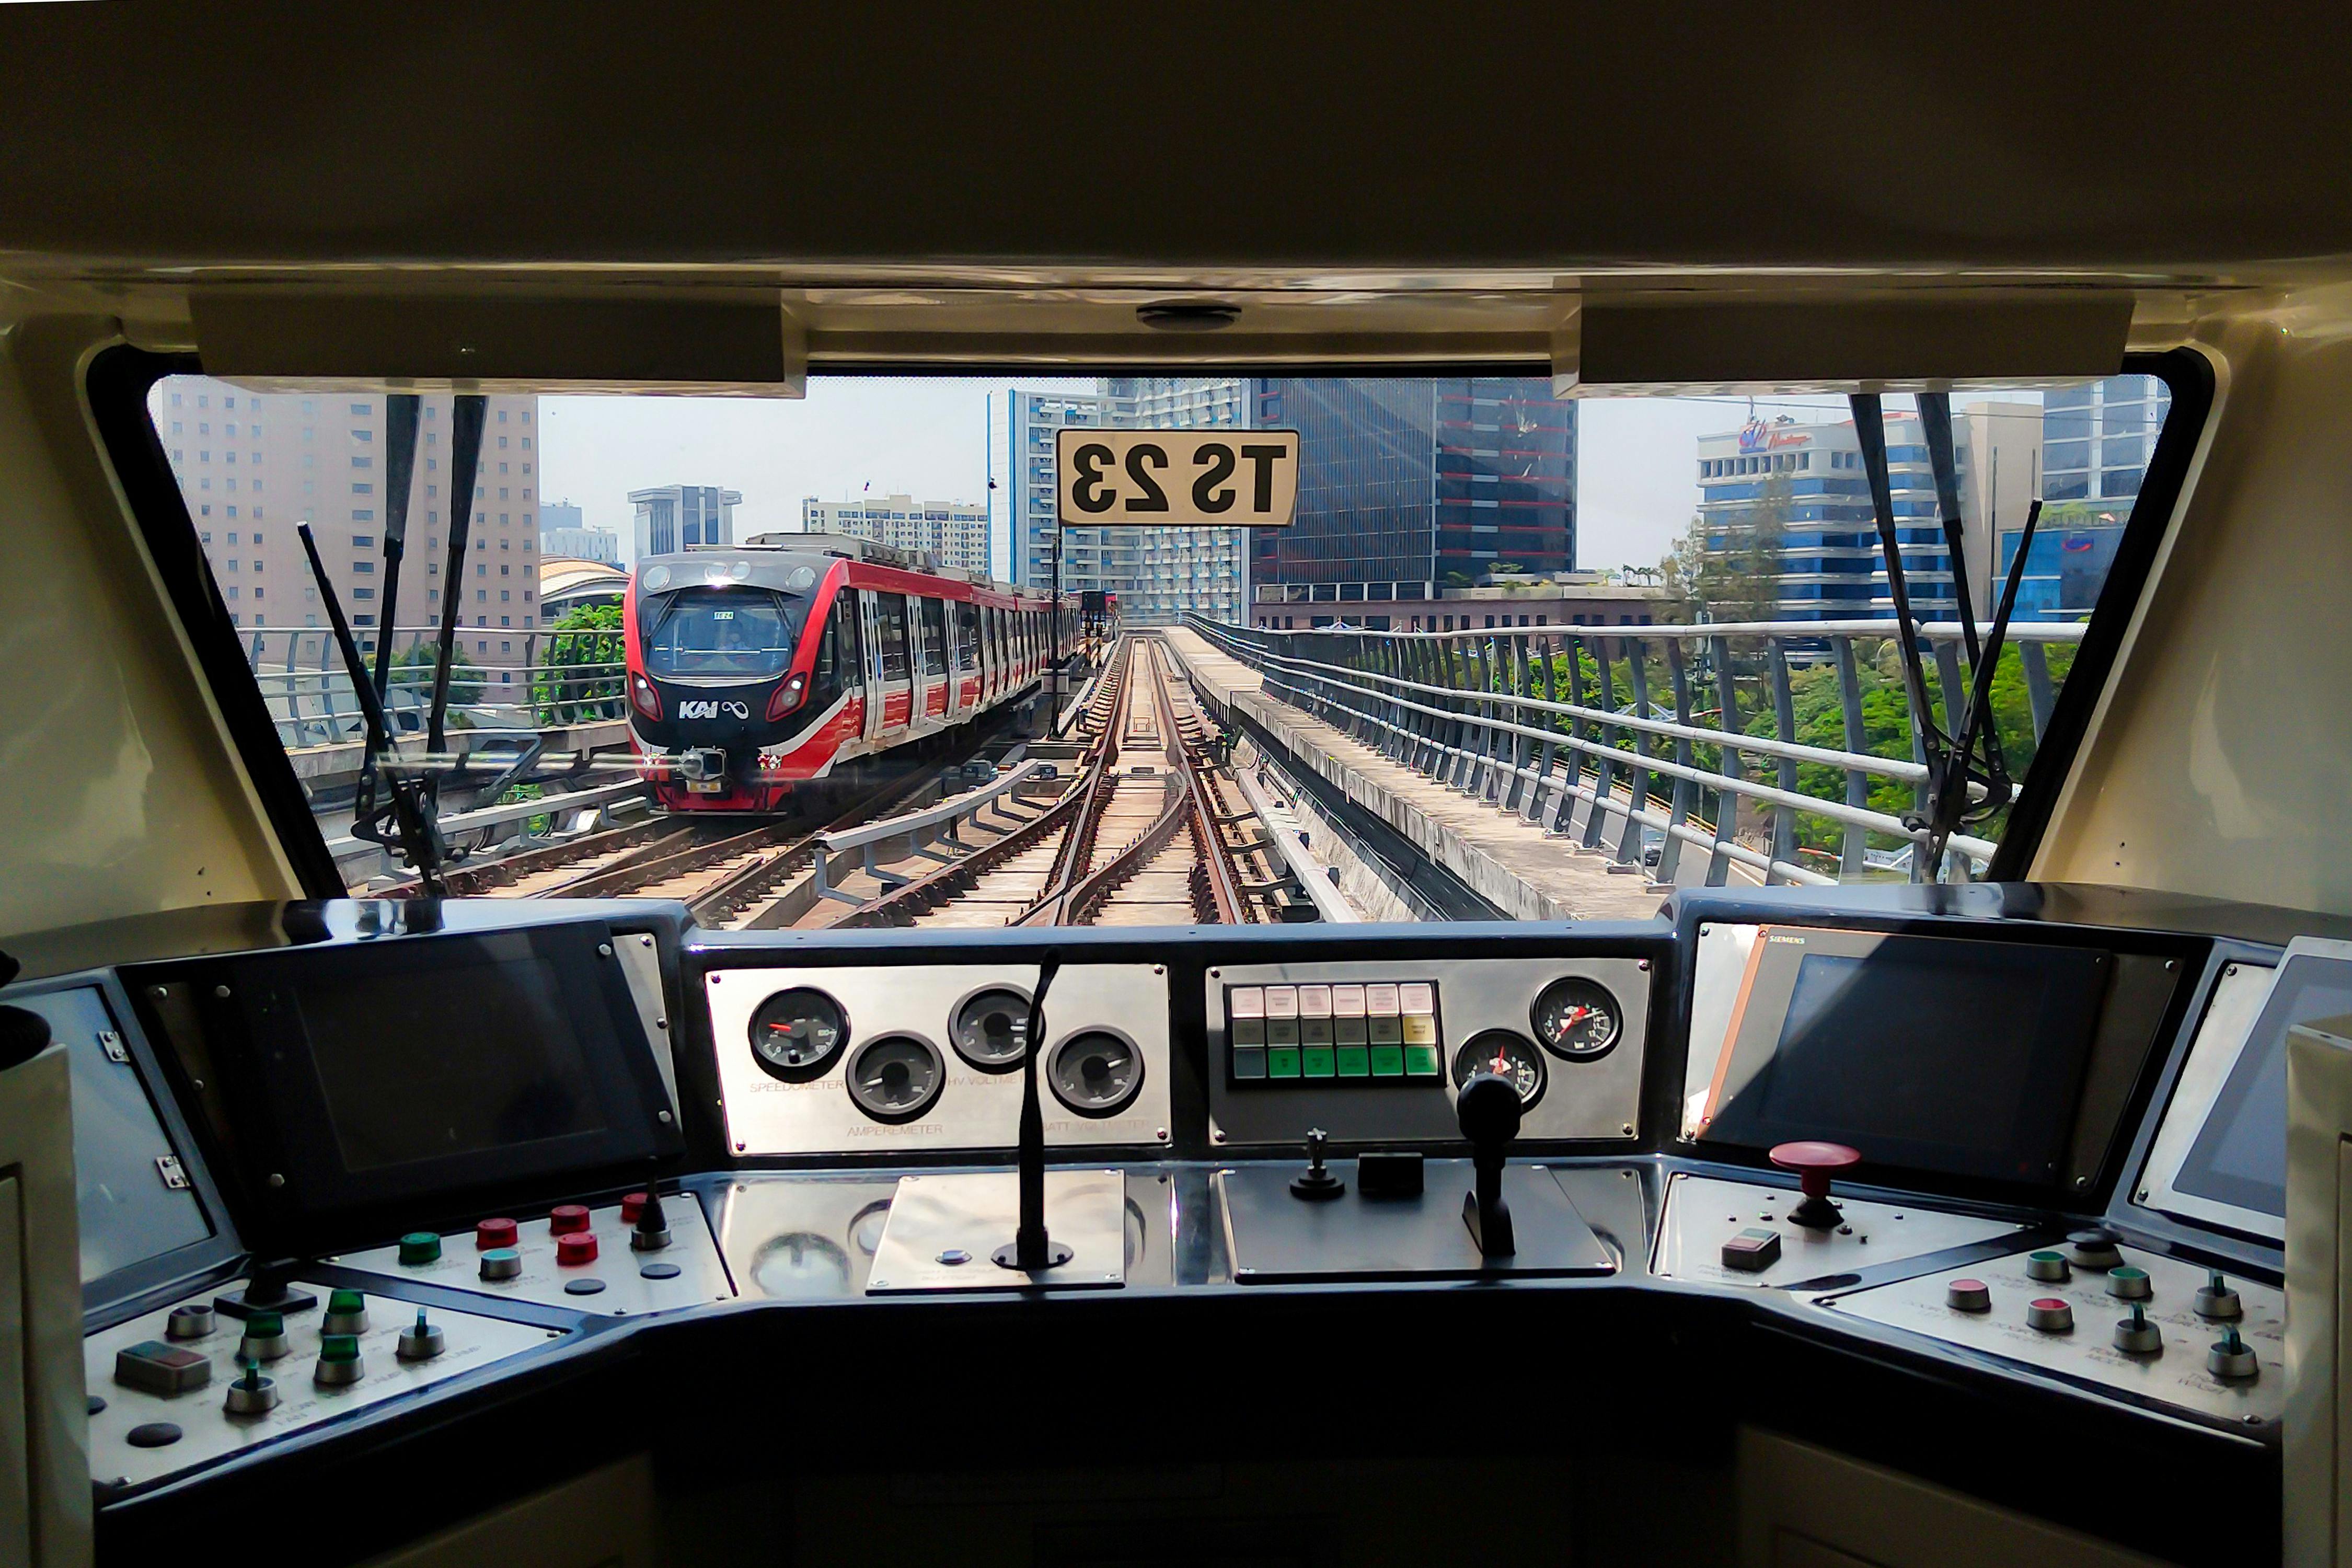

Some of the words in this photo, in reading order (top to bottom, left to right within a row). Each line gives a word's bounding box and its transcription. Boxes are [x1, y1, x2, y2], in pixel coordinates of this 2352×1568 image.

[679, 701, 718, 719] KAI
[1769, 936, 1805, 944] SIEMENS
[750, 1080, 844, 1092] SPEEDOMETER
[846, 1124, 944, 1137] AMPEREMETER
